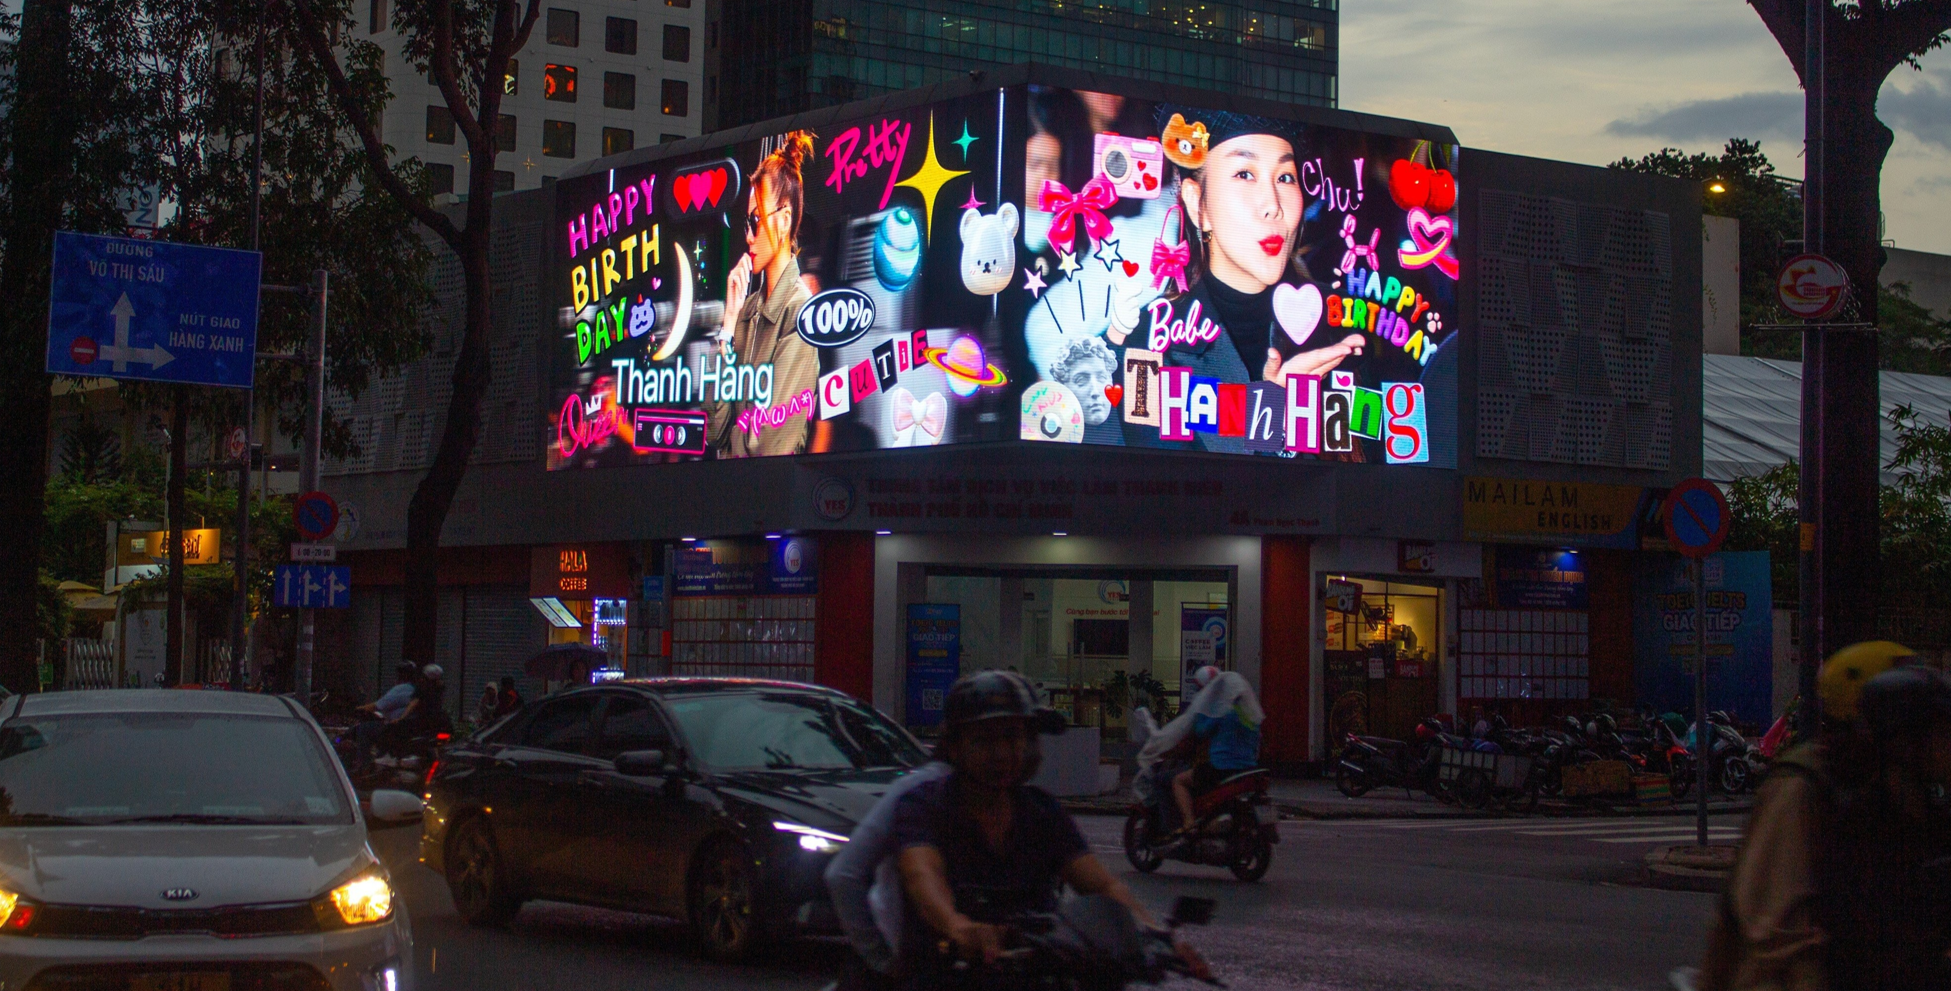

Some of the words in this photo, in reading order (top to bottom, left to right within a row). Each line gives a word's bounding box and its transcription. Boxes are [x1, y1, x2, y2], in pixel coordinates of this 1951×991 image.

[825, 118, 911, 210] Pretty
[568, 174, 656, 258] HAPPY
[89, 259, 108, 278] VÕ
[112, 262, 134, 281] THỊ
[138, 260, 165, 283] SÁU
[571, 223, 660, 315] BIRTH
[800, 298, 873, 335] 100%
[1347, 267, 1429, 323] HAPPY
[169, 330, 206, 350] HÀNG
[209, 334, 244, 353] XANH
[179, 312, 206, 327] NÚT
[210, 315, 241, 330] GIAO
[575, 297, 628, 365] DAY
[1147, 298, 1222, 352] Babe
[1327, 294, 1438, 367] BIRTHDAY
[611, 355, 692, 404] Thanh
[825, 499, 846, 510] YES
[1468, 481, 1579, 509] MAILAM
[1537, 511, 1611, 530] ENGLISH
